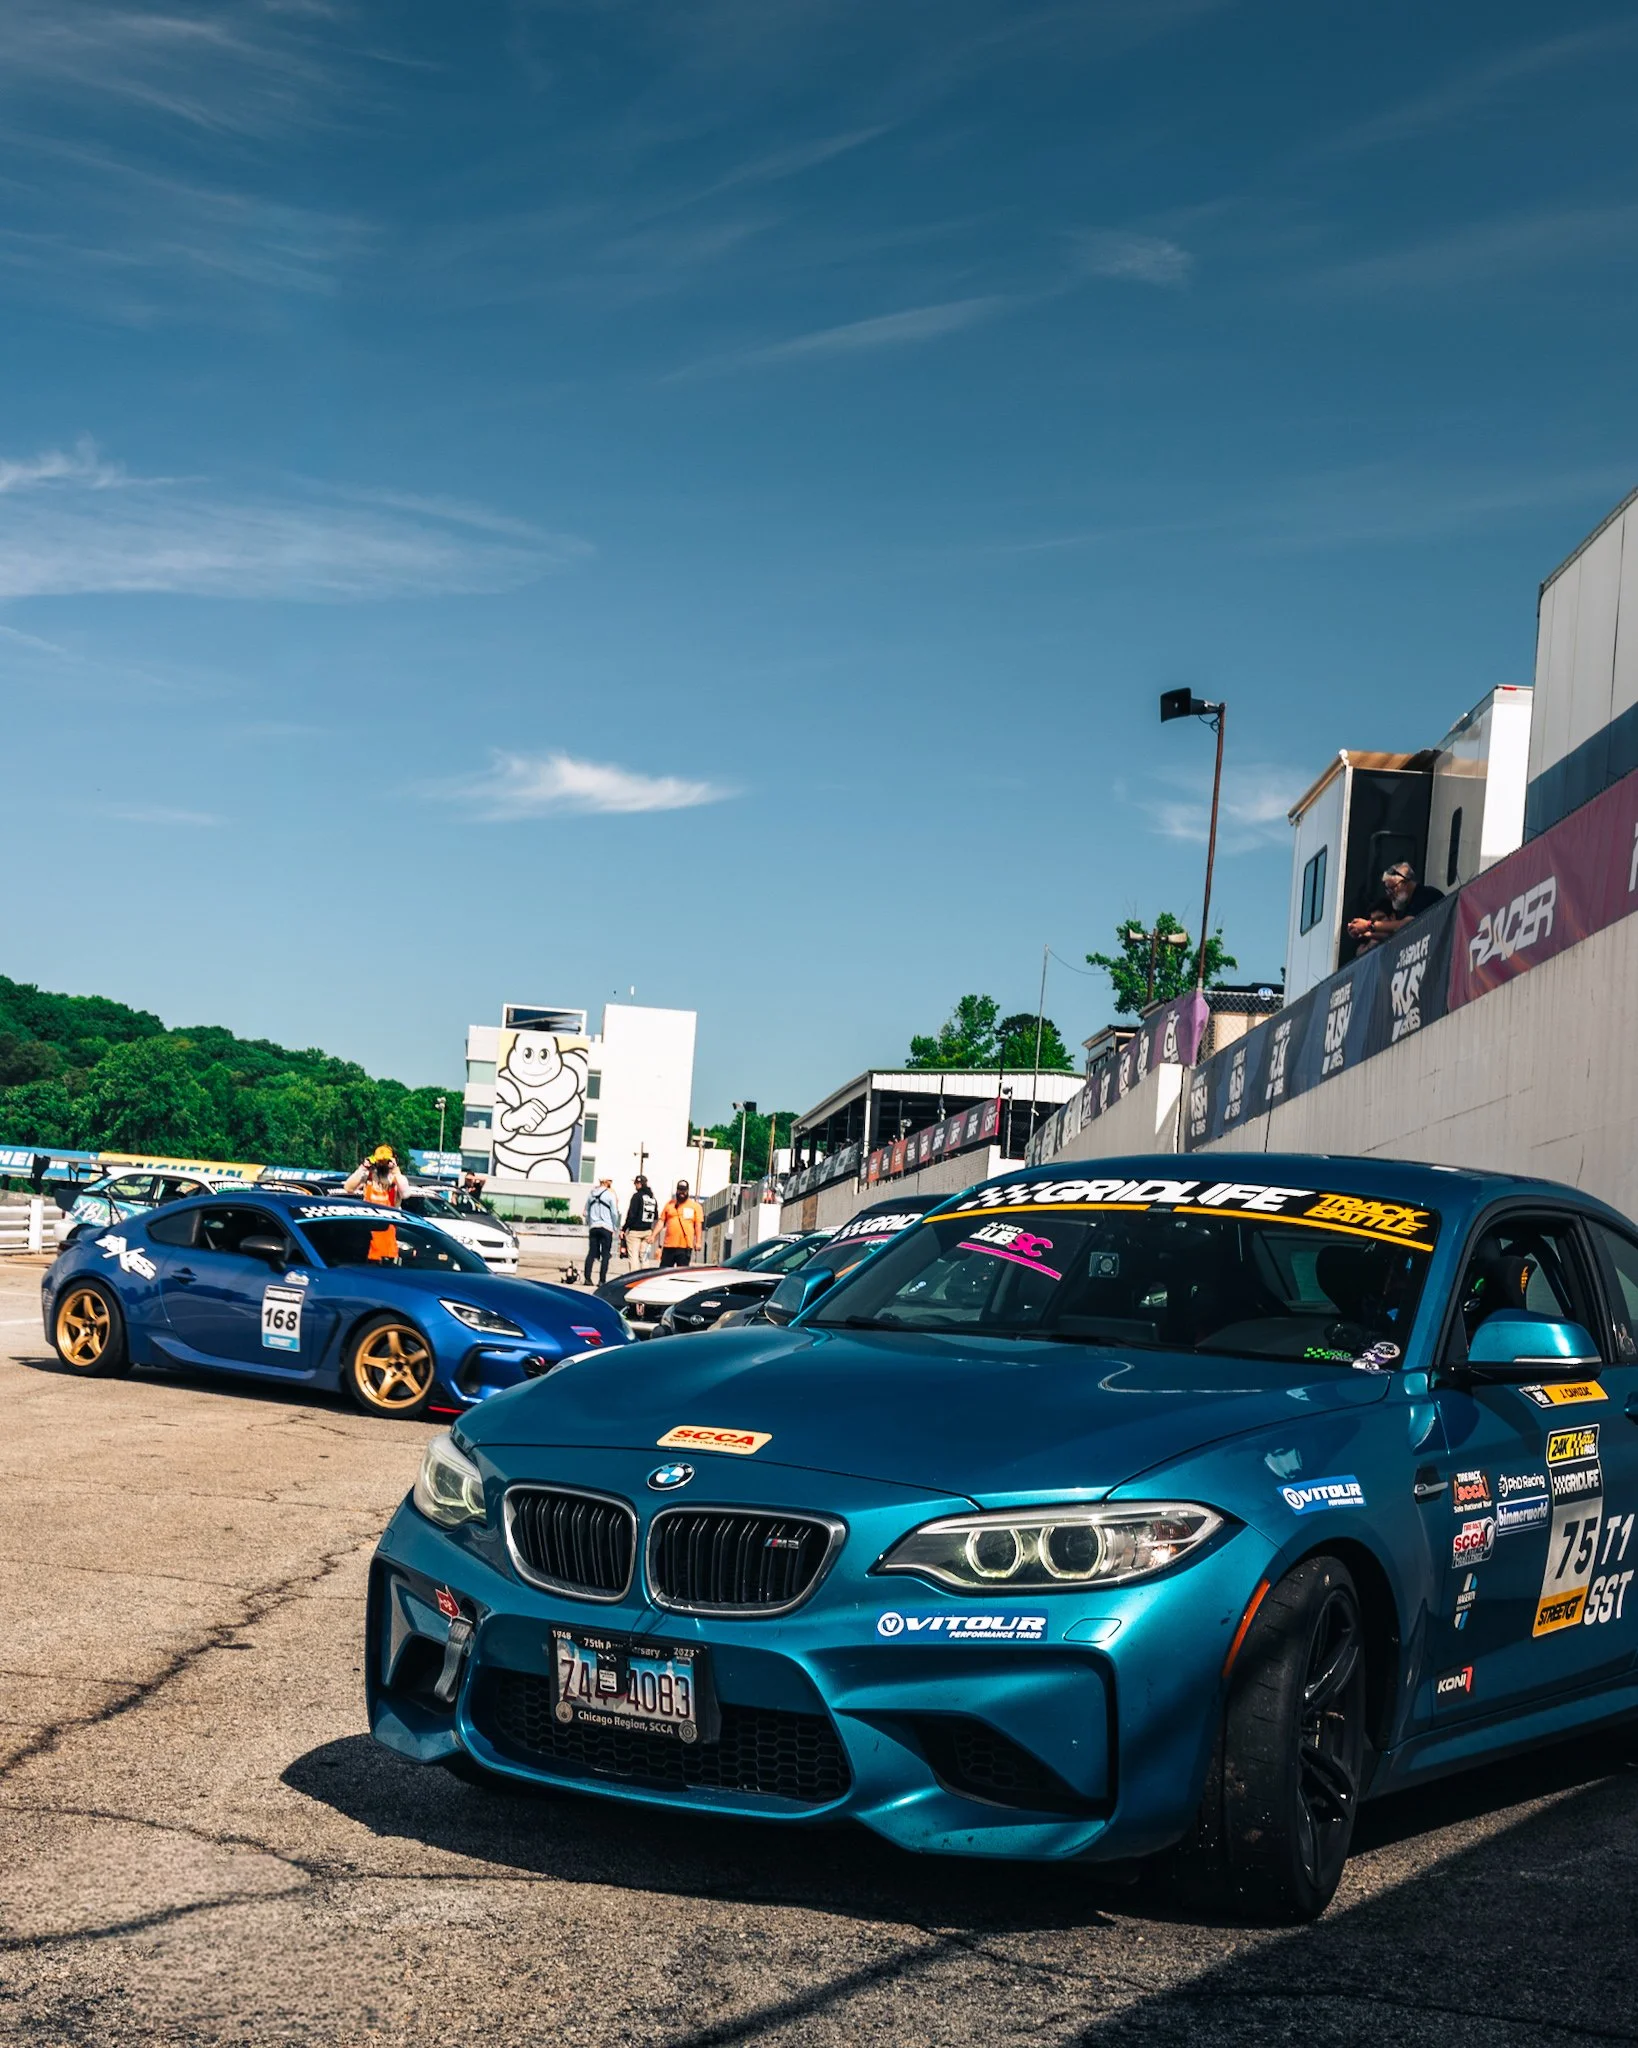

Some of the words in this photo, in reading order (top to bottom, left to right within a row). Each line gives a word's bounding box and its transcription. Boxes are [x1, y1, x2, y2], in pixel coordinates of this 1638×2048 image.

[1469, 875, 1557, 972] RACER
[1032, 1179, 1317, 1212] GRIDLIFE
[1319, 1194, 1430, 1221] TRACK
[1303, 1205, 1428, 1235] BATTLE
[264, 1307, 298, 1331] 168
[673, 1429, 755, 1446] SCCA
[1297, 1483, 1362, 1502] VITOUR
[1457, 1484, 1486, 1500] SCCA
[1522, 1473, 1545, 1489] Racing
[1564, 1469, 1600, 1494] GRIDLIFE
[1499, 1501, 1548, 1527] bimmerworld
[1454, 1531, 1486, 1552] SCCA
[1555, 1516, 1598, 1580] 75
[1600, 1513, 1635, 1565] T1
[1584, 1569, 1635, 1626] SST
[905, 1616, 1047, 1631] VITOUR
[949, 1631, 1013, 1639] PERFORMANCE
[1015, 1631, 1041, 1640] TIRES
[552, 1630, 572, 1640] 1948
[583, 1637, 604, 1649] 75th
[673, 1647, 695, 1658] 2023
[625, 1669, 691, 1718] 4083
[1437, 1673, 1467, 1694] KONI
[578, 1710, 613, 1726] Chicago
[614, 1716, 648, 1731] Region,
[649, 1722, 673, 1735] SCCA
